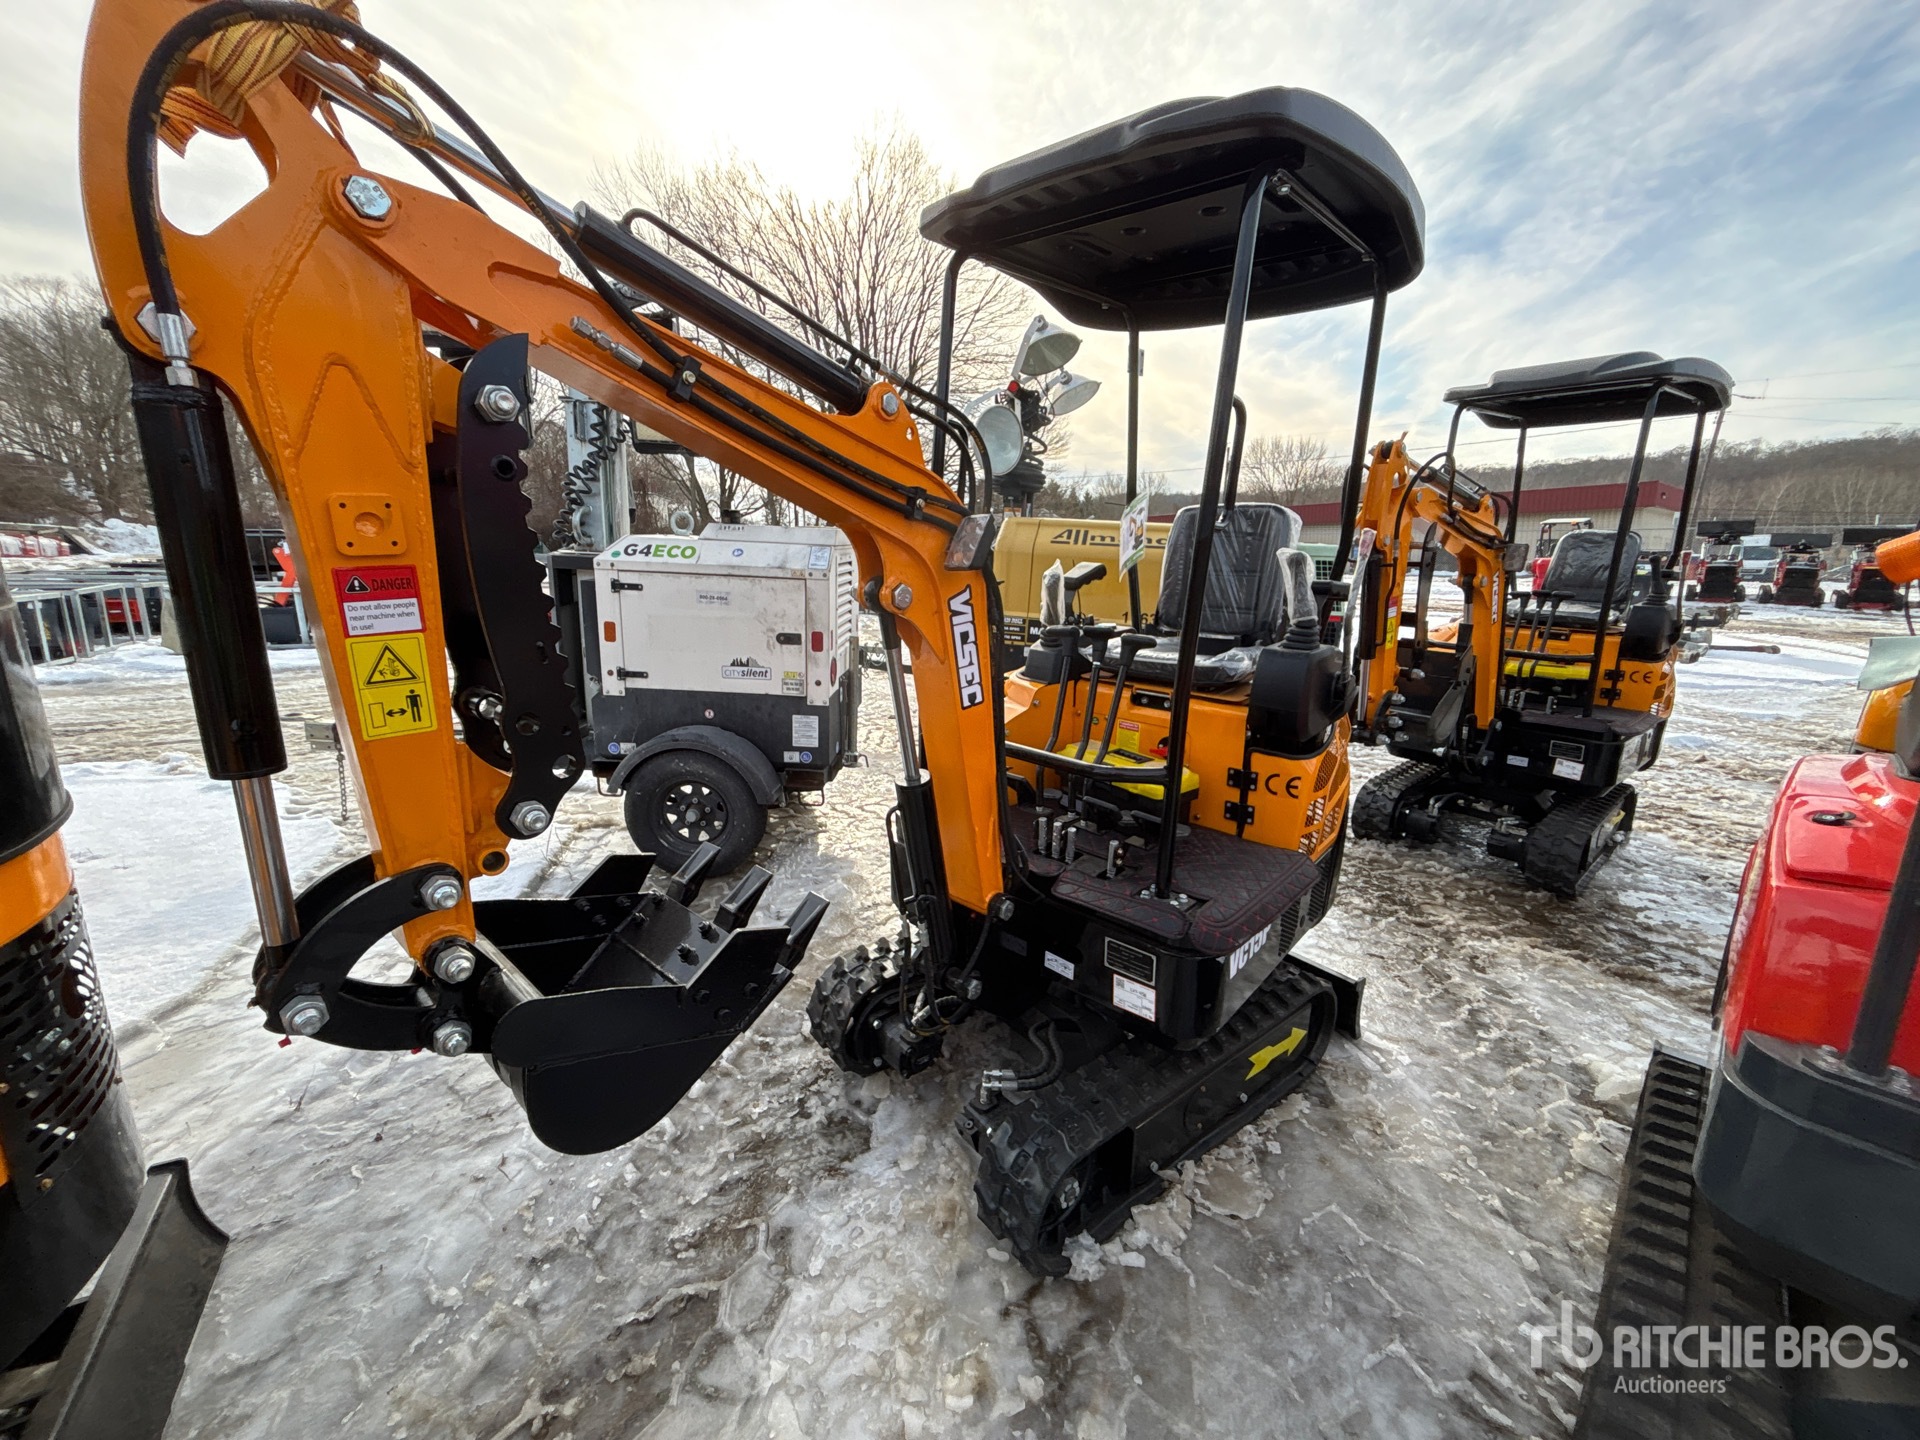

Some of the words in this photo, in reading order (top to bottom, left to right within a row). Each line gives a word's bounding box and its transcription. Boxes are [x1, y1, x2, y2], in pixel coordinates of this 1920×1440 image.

[623, 543, 697, 560] G4ECO
[371, 578, 413, 591] DANGER
[347, 604, 359, 612] Do
[373, 602, 392, 611] allow
[393, 600, 416, 610] people
[366, 612, 396, 620] machine
[397, 610, 416, 618] when
[360, 623, 374, 631] use!
[948, 584, 984, 709] VICSEC
